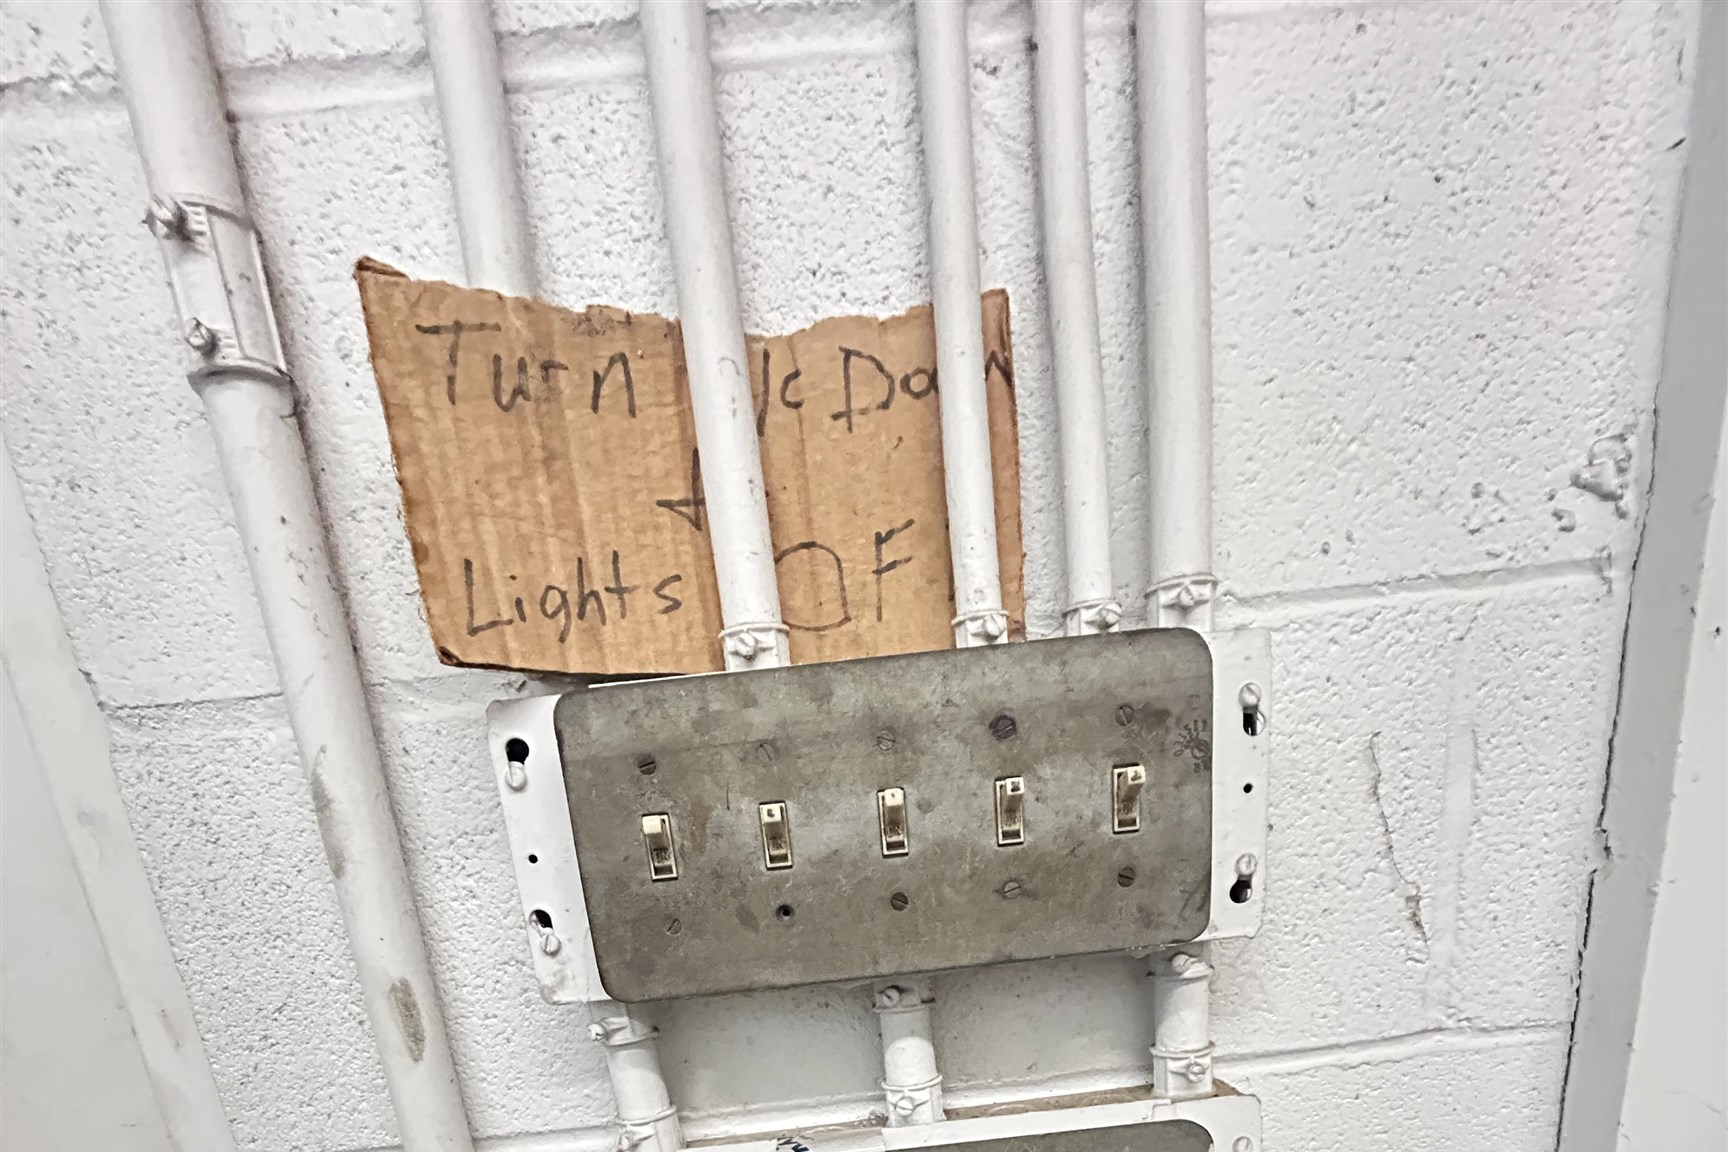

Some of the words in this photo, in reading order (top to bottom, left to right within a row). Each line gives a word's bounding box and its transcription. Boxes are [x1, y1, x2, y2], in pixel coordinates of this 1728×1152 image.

[414, 320, 638, 419] Turn
[831, 345, 1013, 434] Don
[463, 550, 683, 643] Lights
[774, 519, 915, 632] OF
